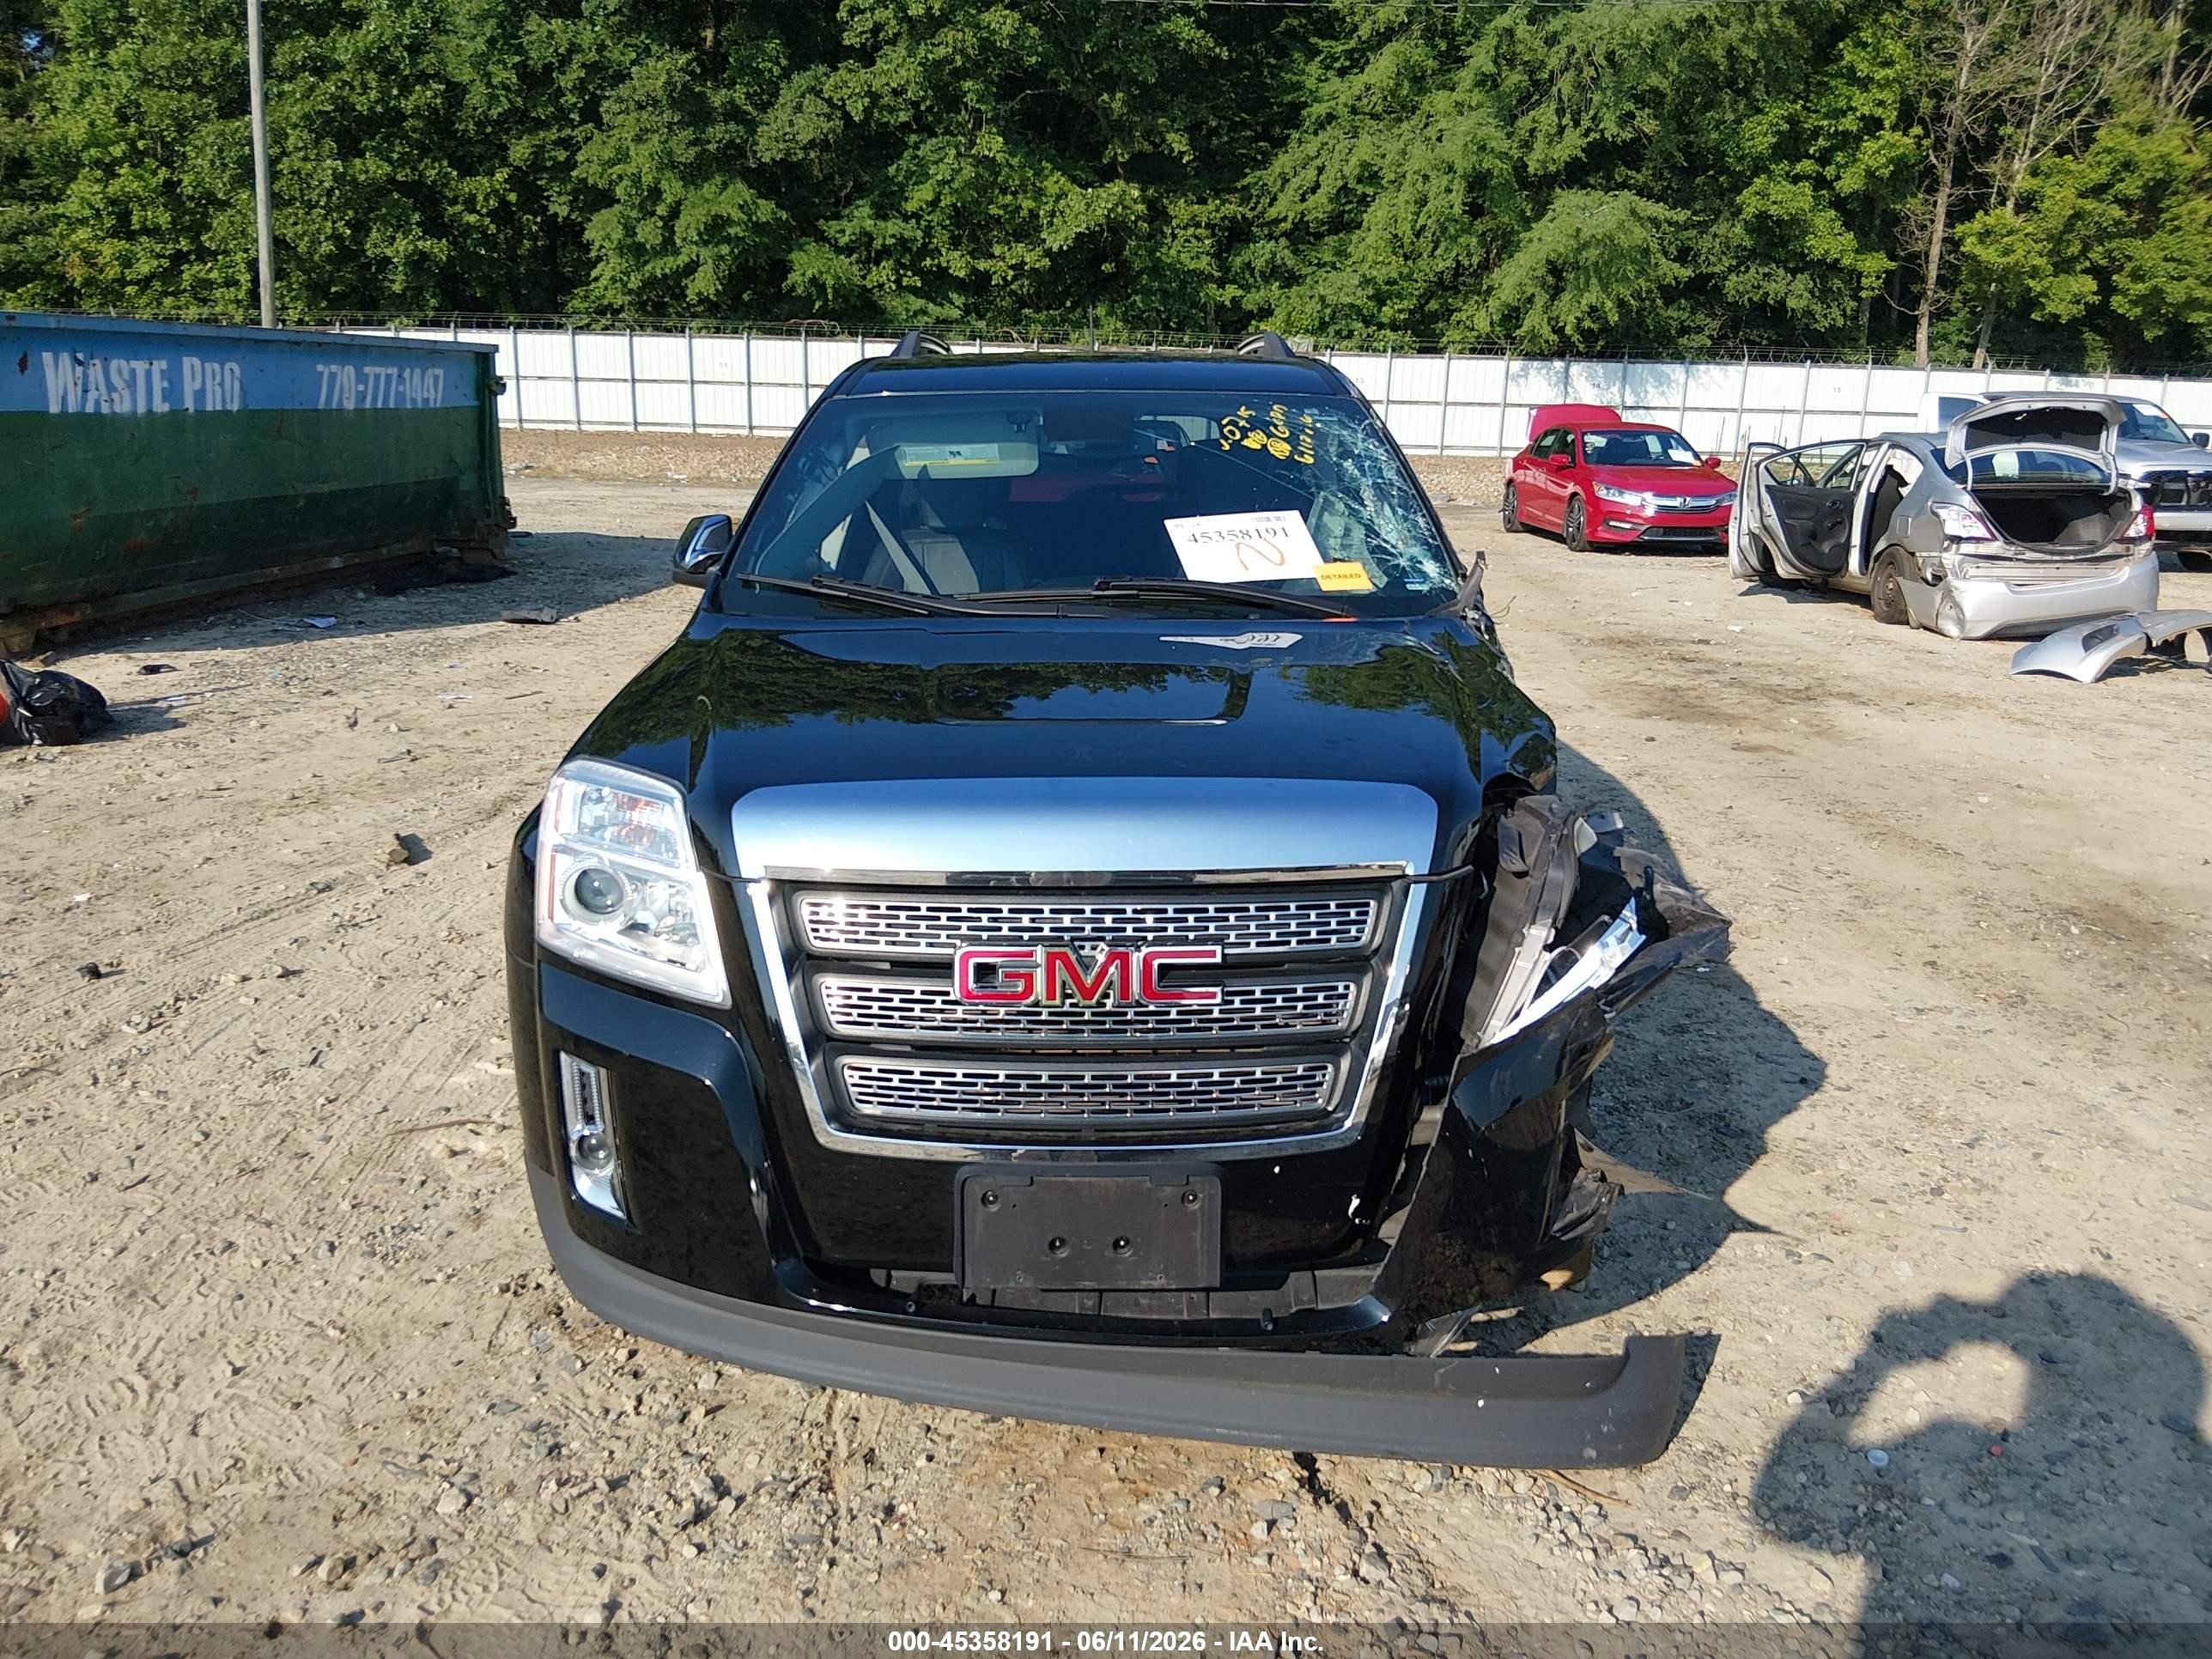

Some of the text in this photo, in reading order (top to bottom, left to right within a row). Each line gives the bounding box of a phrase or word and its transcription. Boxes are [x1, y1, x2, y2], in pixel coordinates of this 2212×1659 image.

[316, 364, 445, 410] 770-777-1447
[1188, 526, 1289, 544] 45358191
[1321, 573, 1362, 581] DETAILED
[953, 944, 1224, 1006] GMC
